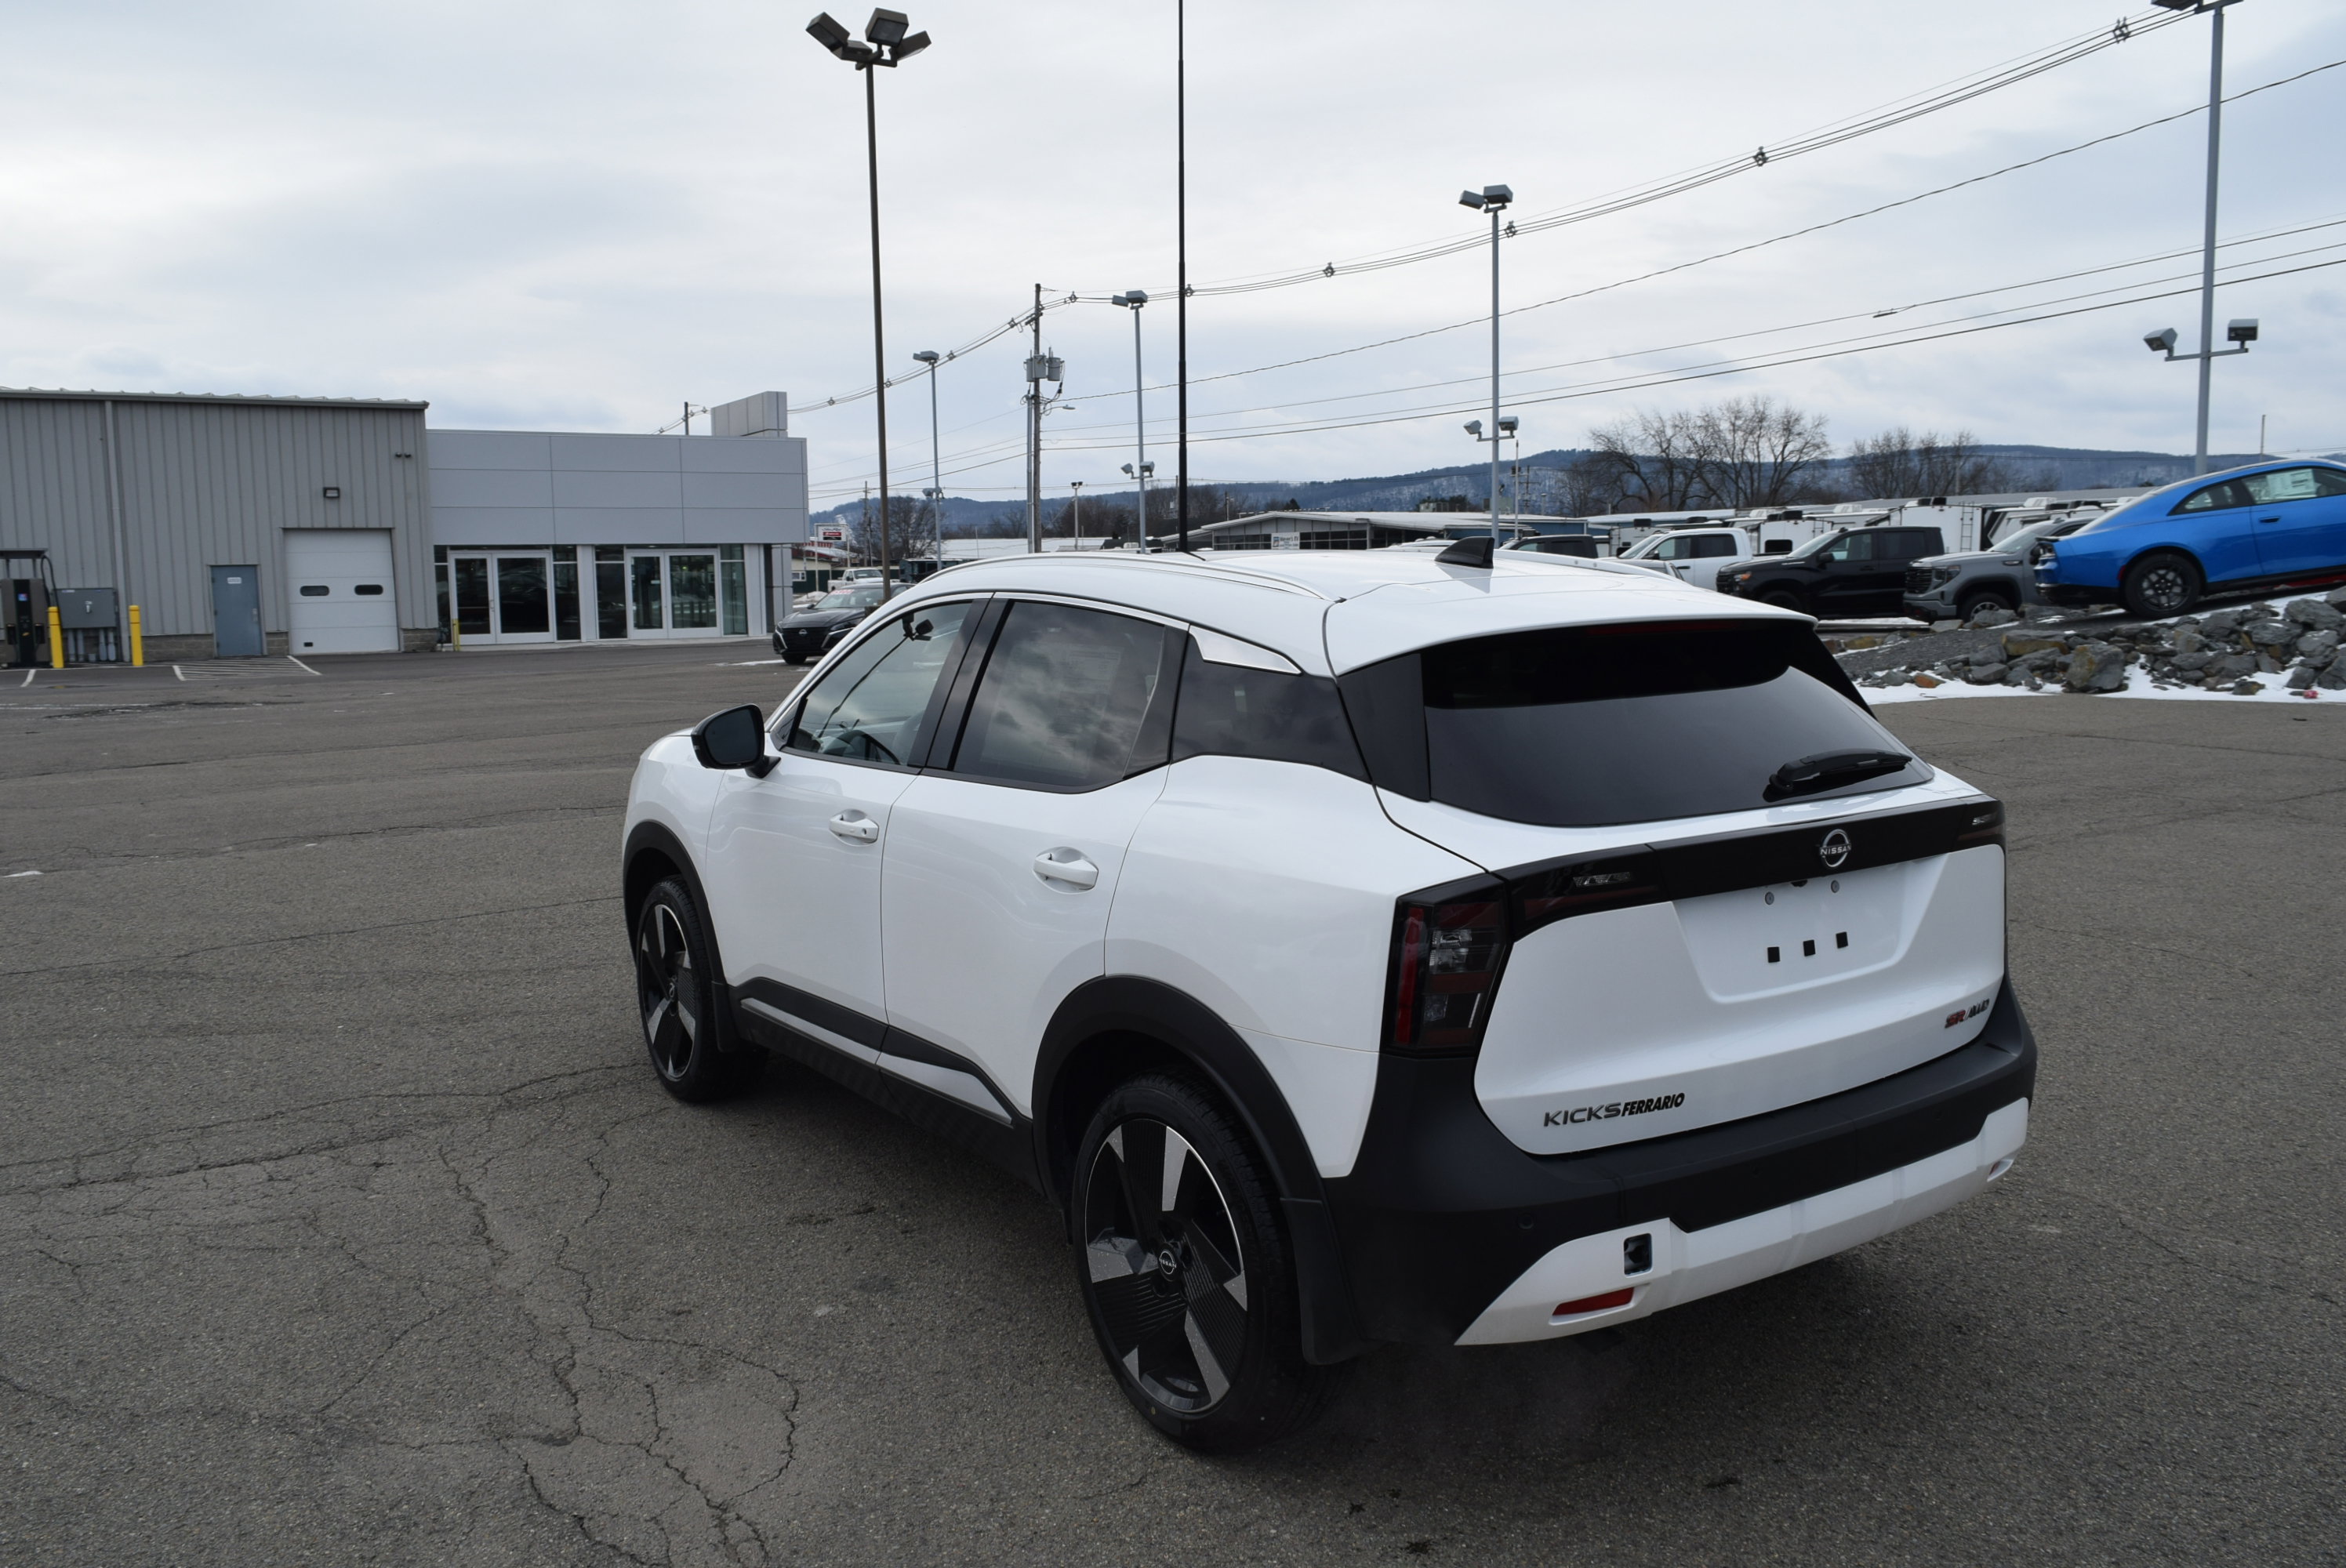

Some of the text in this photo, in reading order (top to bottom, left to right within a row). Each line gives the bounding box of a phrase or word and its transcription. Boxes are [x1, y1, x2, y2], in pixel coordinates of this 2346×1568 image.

[1820, 845, 1851, 855] NISSAN
[1543, 1092, 1685, 1127] KICKS FERRARIO
